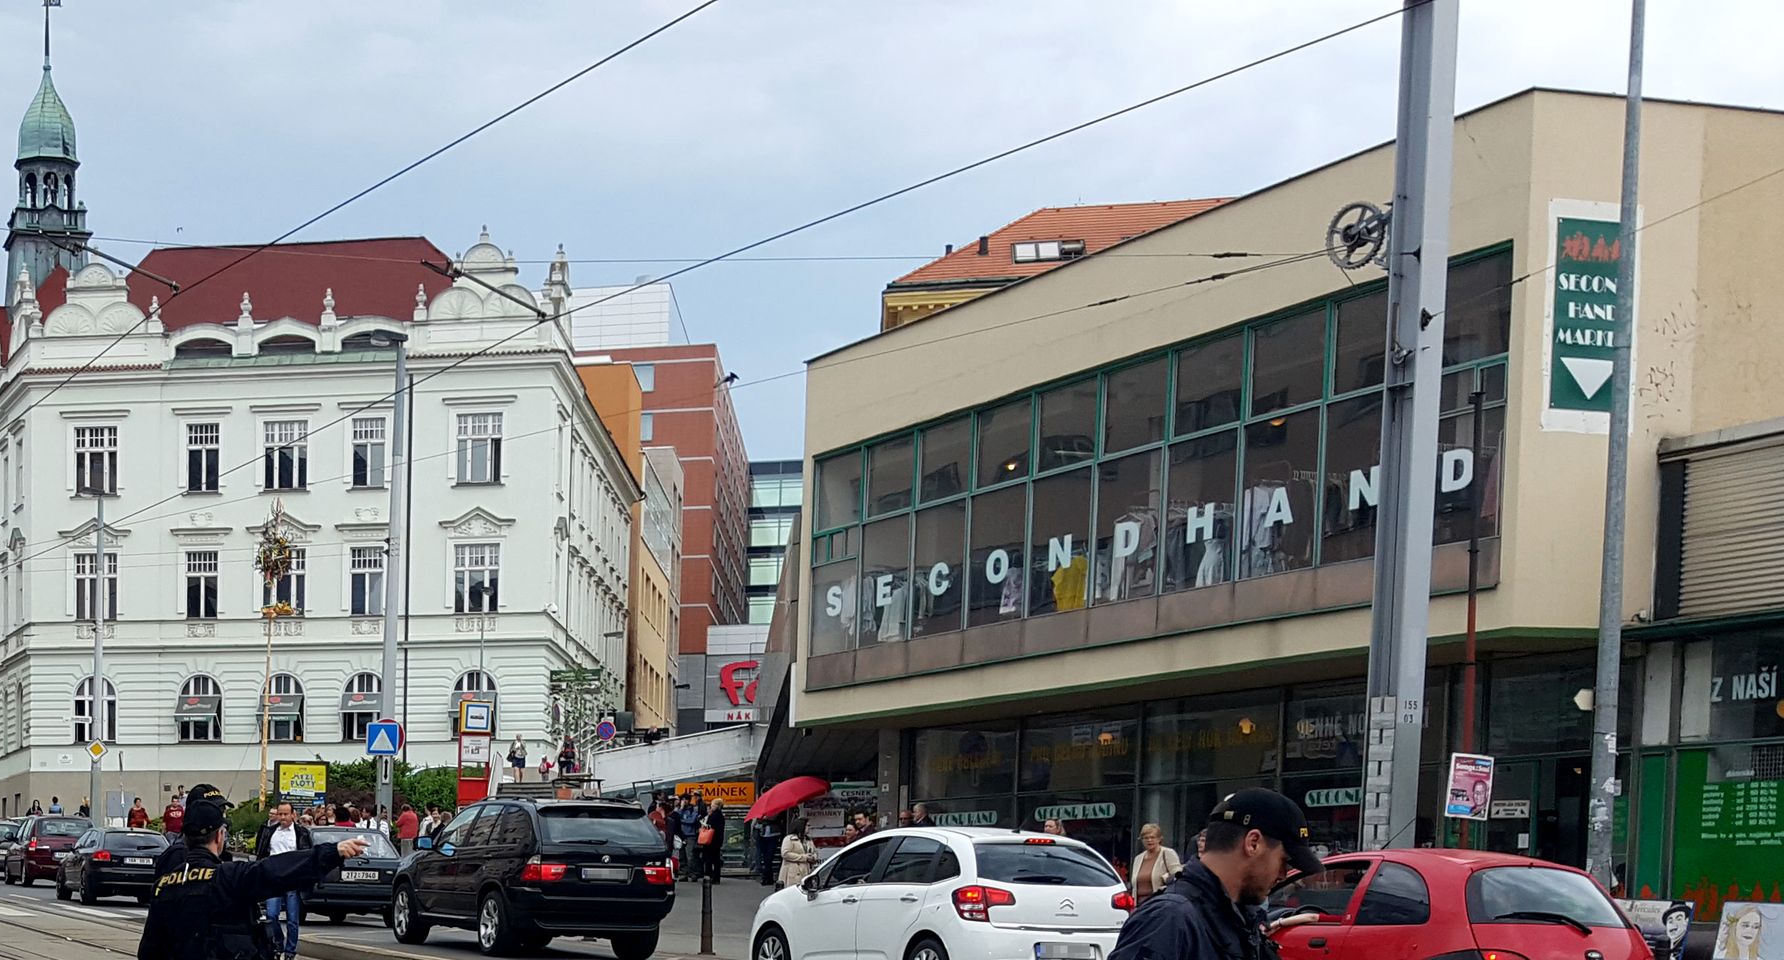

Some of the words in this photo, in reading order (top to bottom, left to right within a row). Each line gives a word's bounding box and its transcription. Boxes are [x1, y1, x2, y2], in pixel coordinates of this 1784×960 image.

[1558, 272, 1617, 294] SECON
[1556, 327, 1614, 347] MARK
[826, 522, 1142, 618] SECOND
[1186, 448, 1474, 544] HAND
[1710, 677, 1723, 702] Z
[1731, 665, 1778, 700] NAŠÍ
[727, 711, 750, 720] NÁK
[1404, 701, 1418, 710] 155
[1403, 714, 1414, 723] 03
[684, 785, 748, 797] JEMÍNEK
[158, 867, 215, 887] POLCIE
